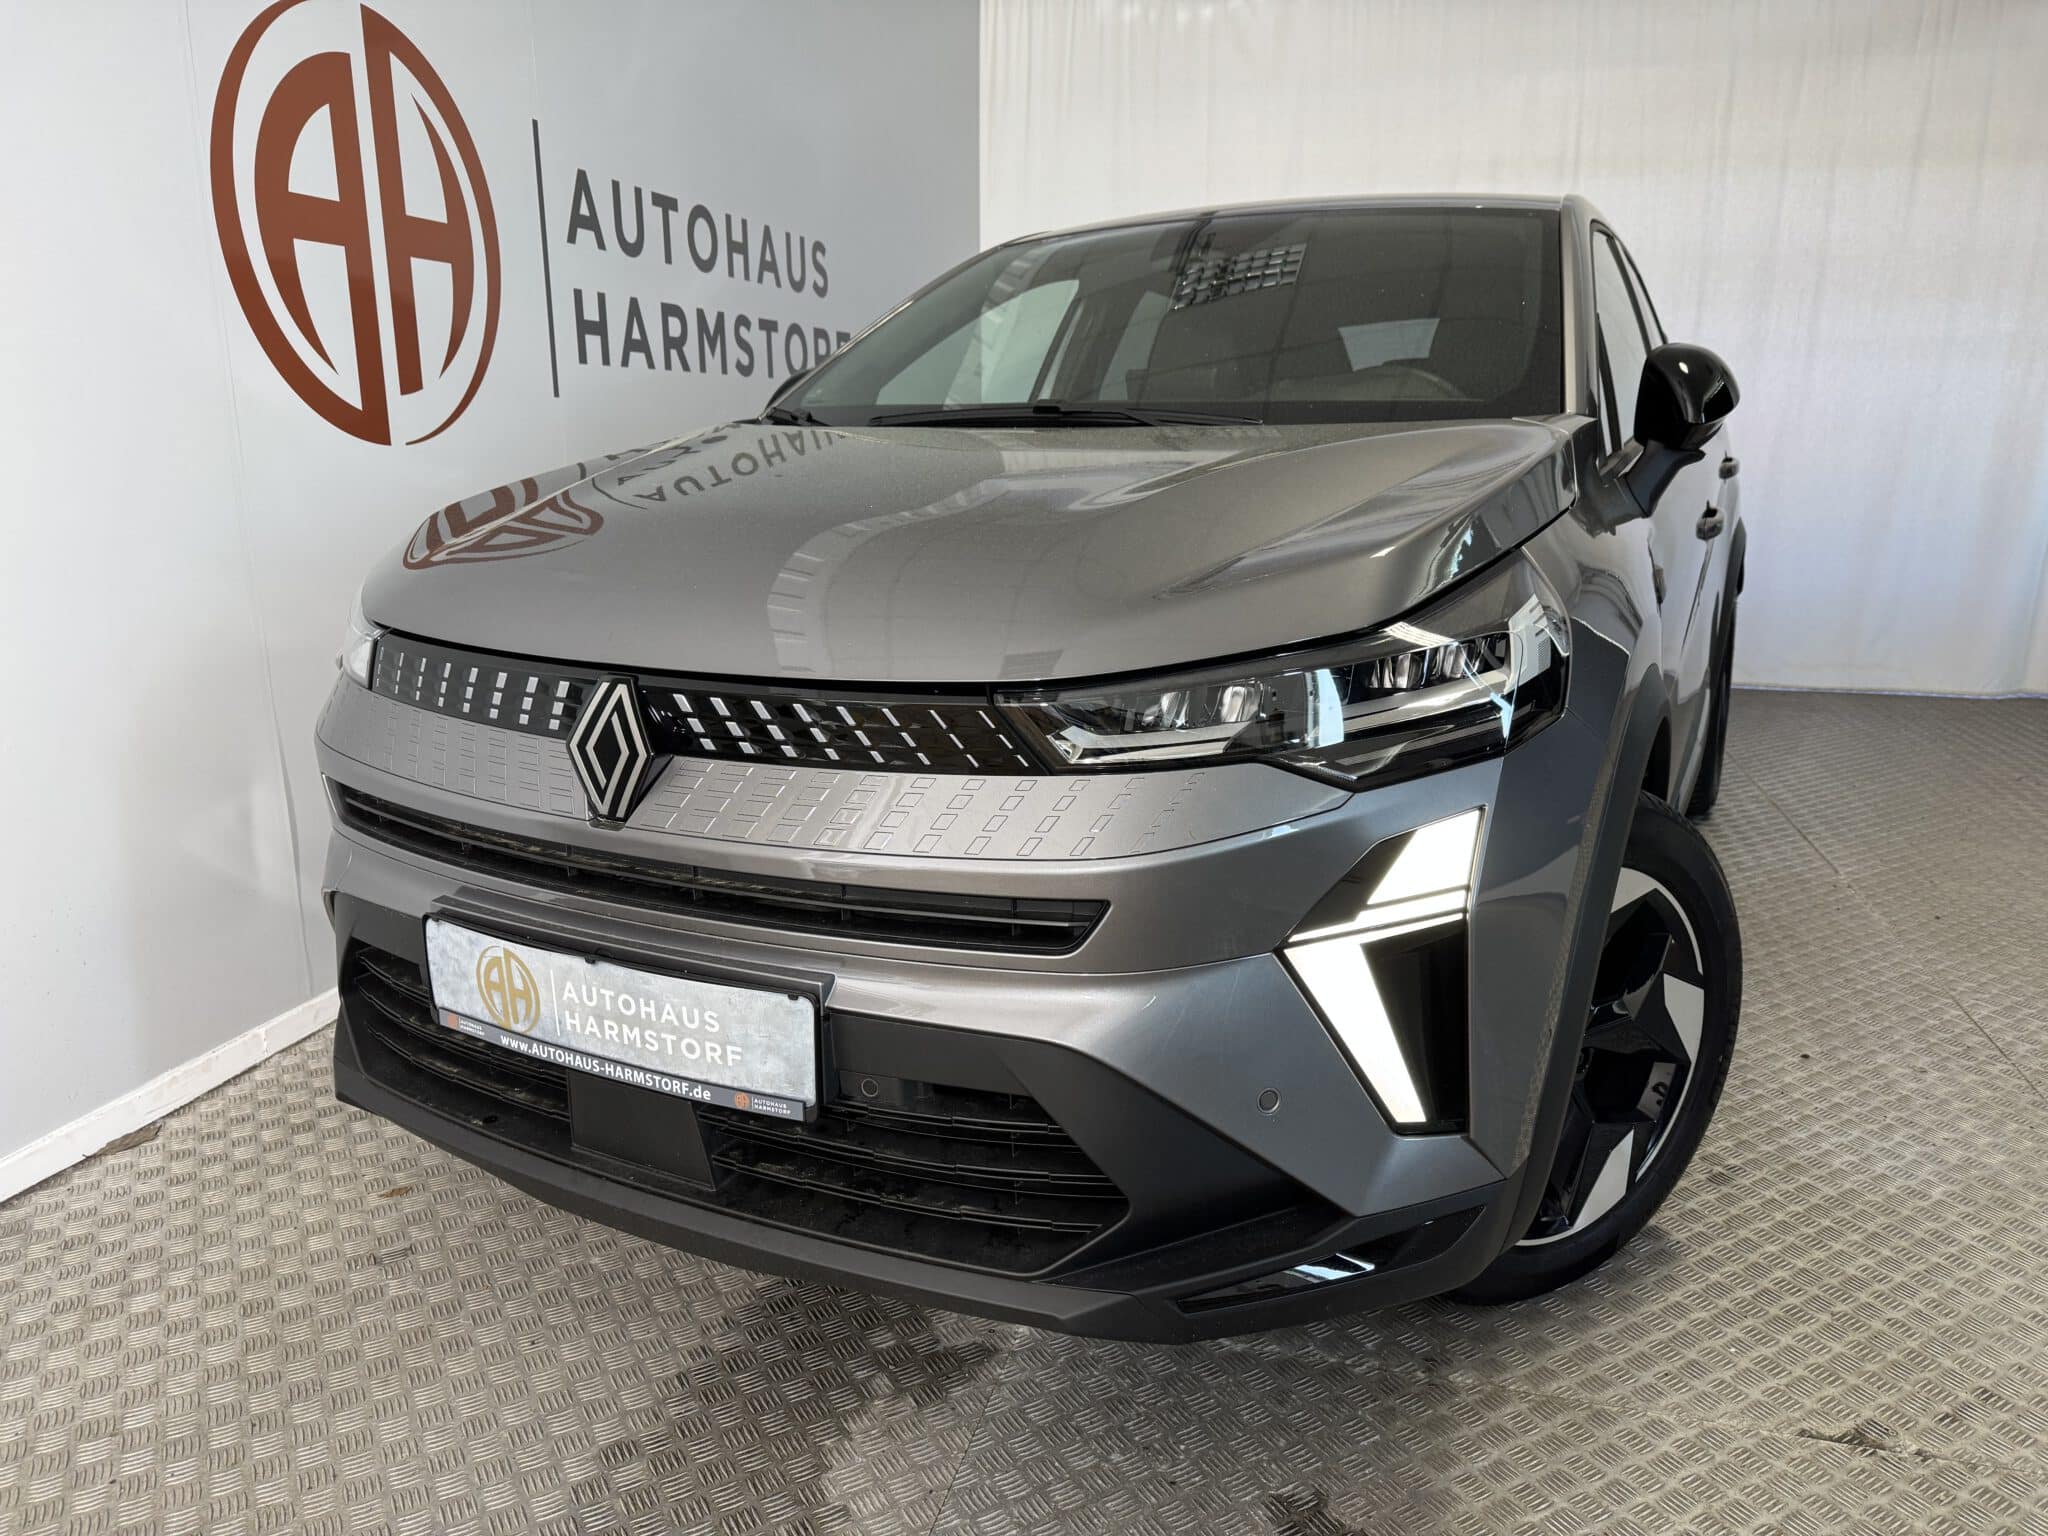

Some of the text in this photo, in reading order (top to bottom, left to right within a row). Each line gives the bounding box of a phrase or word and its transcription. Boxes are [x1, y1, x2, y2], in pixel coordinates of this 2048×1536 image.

[567, 168, 829, 298] AUTOHAUS
[562, 981, 720, 1033] AUTOHAUS
[501, 1034, 711, 1100] www.AUTOHAUS-HARMSTORF.de
[565, 1011, 743, 1066] HARMSTORF
